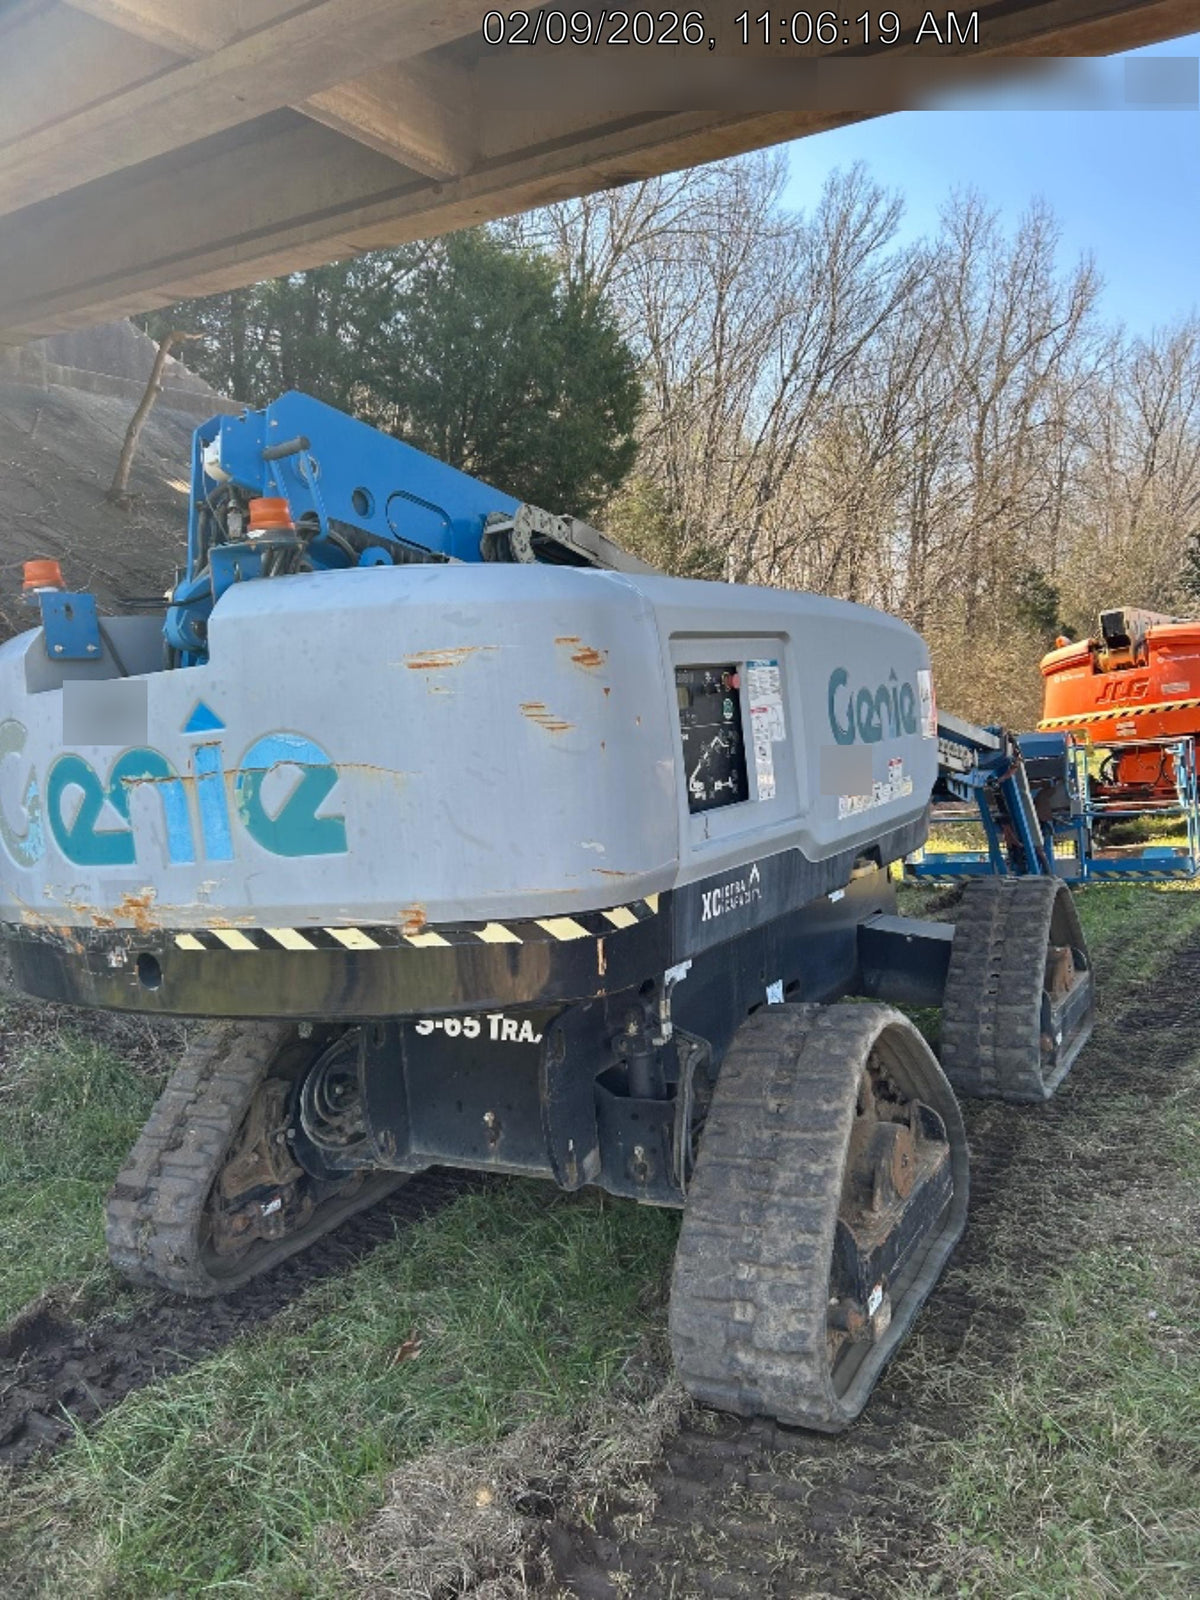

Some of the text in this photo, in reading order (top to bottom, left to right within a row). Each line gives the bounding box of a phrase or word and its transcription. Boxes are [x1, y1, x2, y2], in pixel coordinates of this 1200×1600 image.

[828, 667, 916, 745] Genie
[701, 888, 720, 921] XC
[487, 1013, 543, 1044] TRA
